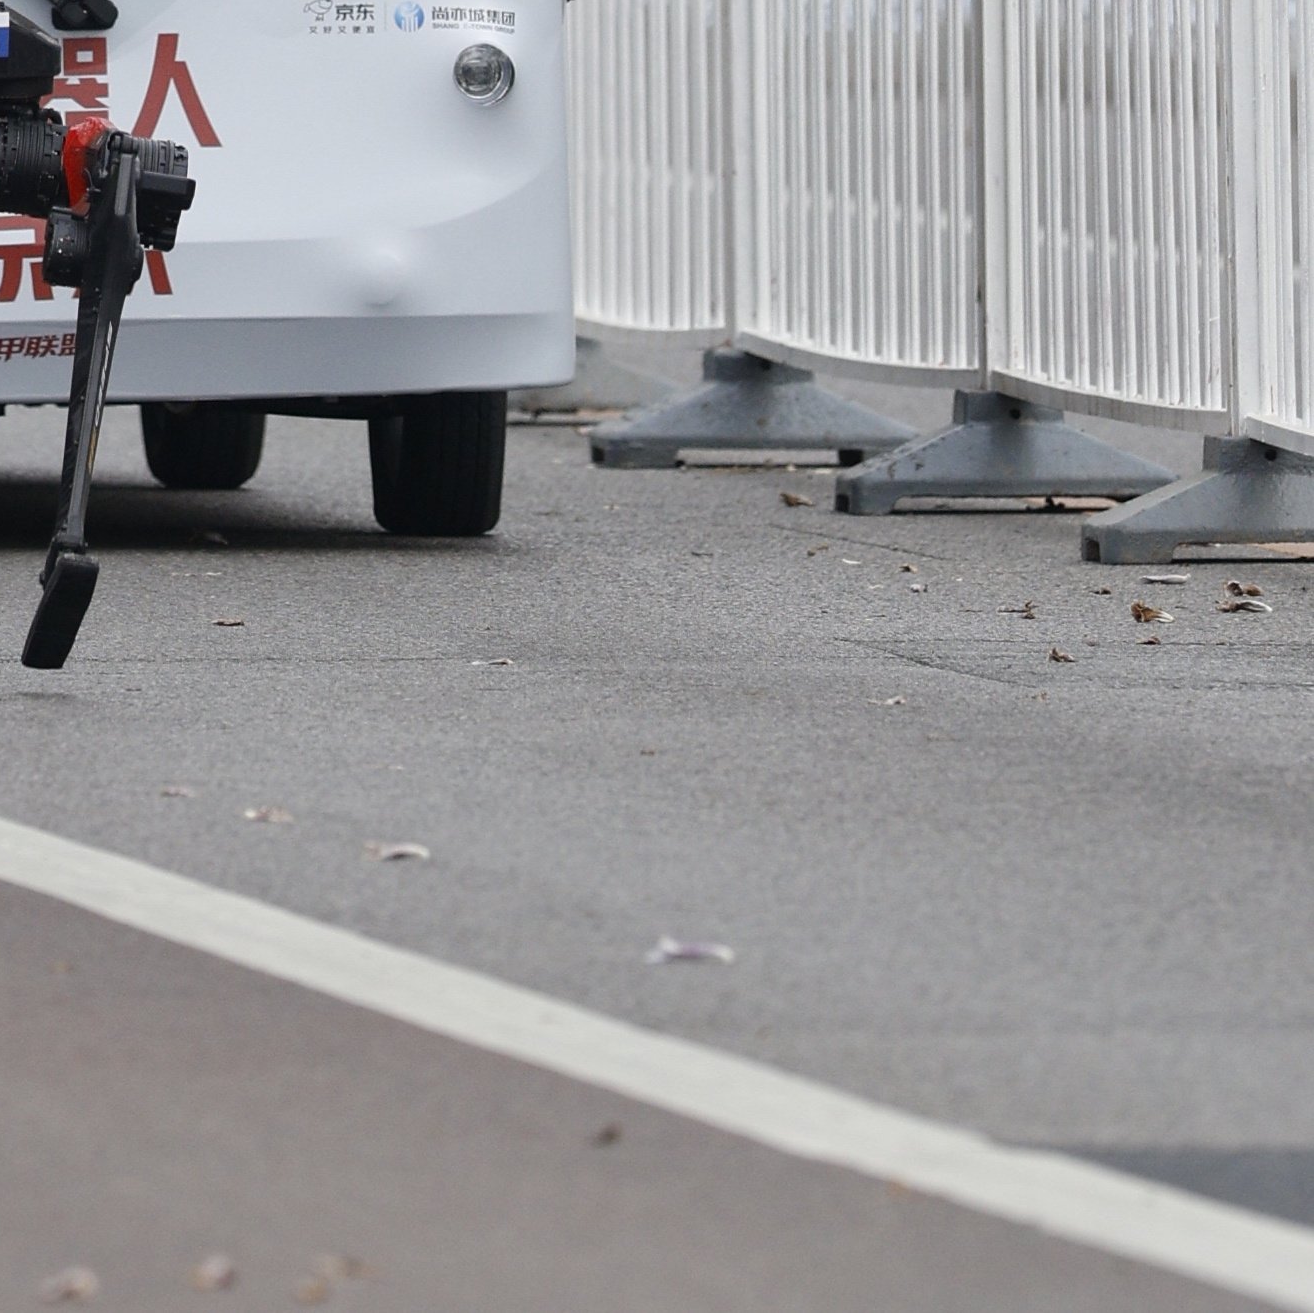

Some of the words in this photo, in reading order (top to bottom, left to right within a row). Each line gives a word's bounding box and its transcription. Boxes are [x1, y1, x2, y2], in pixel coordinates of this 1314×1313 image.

[335, 3, 375, 21] 京东
[432, 6, 515, 27] 尚亦城集团
